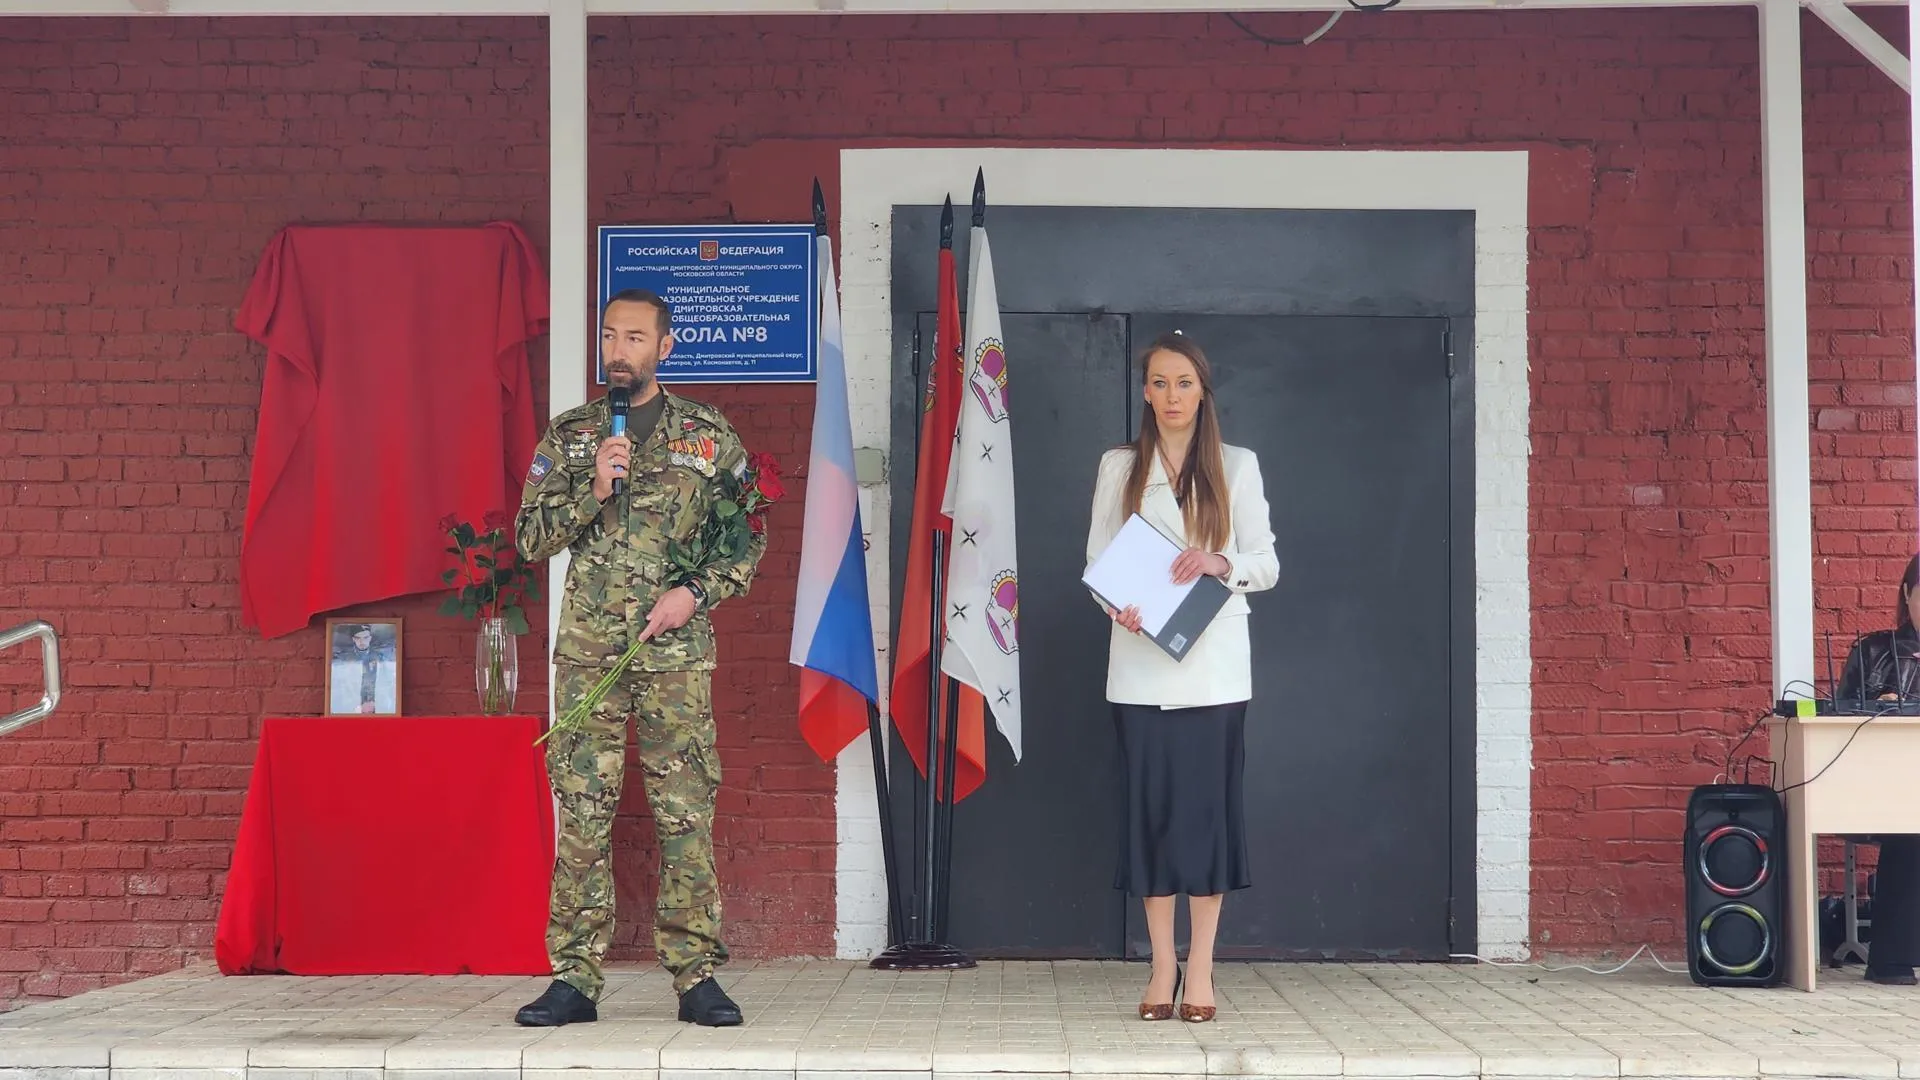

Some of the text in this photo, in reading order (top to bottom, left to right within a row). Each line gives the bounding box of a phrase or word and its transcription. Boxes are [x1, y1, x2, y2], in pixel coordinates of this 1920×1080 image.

[628, 246, 784, 256] РОССИЙСКАЯ ФЕДЕРАЦИЯ
[667, 286, 750, 294] МУНИЦИПАЛЬНОЕ
[737, 295, 800, 303] УЧРЕЖДЕНИЕ
[673, 305, 743, 314] ДМИТРОВСКАЯ
[671, 314, 790, 323] ОБЩЕОБРАЗОВАТЕЛЬНАЯ
[669, 326, 768, 343] КОЛА №8
